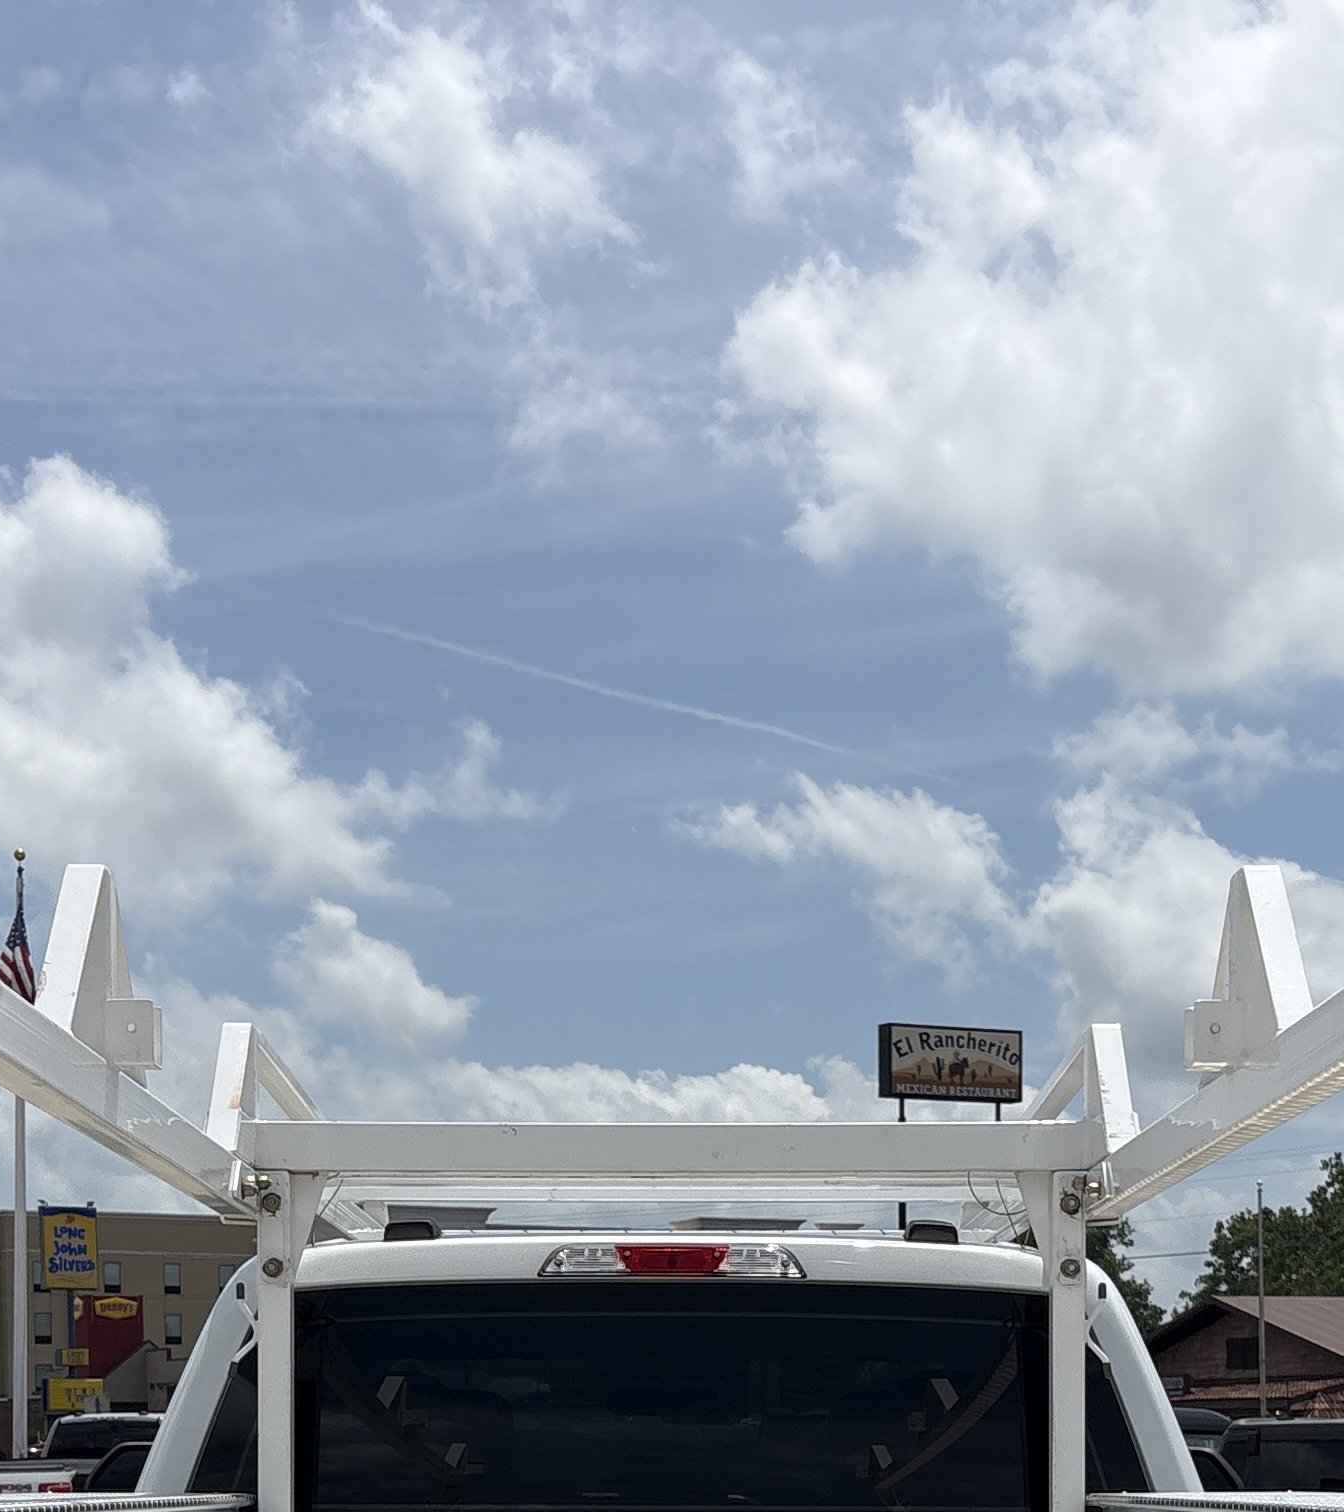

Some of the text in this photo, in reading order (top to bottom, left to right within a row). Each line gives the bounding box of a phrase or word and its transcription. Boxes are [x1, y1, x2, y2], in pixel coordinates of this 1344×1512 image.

[892, 1031, 1020, 1066] El Rancherito
[896, 1083, 1018, 1098] MEXICAN RESTAURANT
[53, 1226, 86, 1240] LONG
